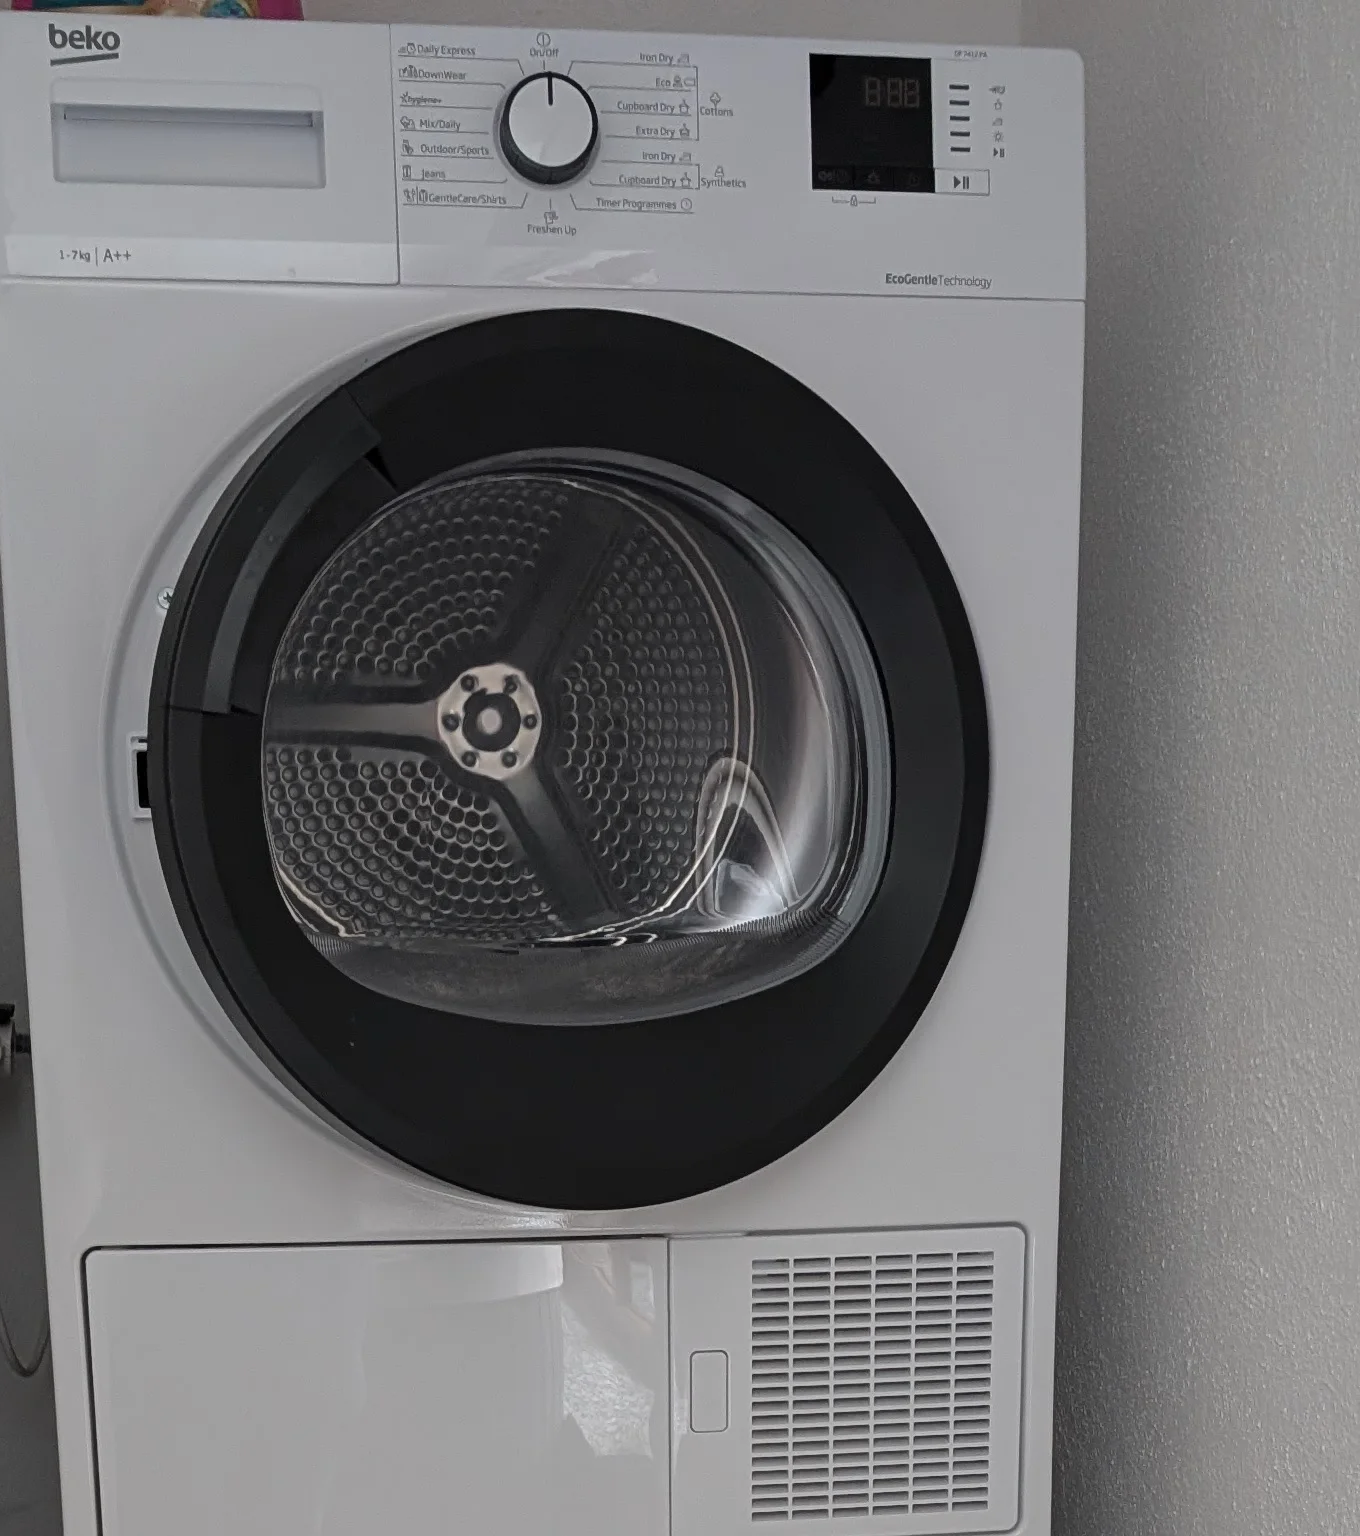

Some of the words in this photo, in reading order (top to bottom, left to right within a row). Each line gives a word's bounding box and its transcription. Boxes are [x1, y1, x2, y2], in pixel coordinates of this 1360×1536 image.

[47, 23, 121, 51] beko
[418, 45, 439, 55] Daily
[441, 46, 476, 56] Express
[529, 48, 559, 58] On/Off
[640, 53, 657, 61] Iron
[659, 54, 674, 63] Dry
[656, 78, 671, 87] Eco
[617, 100, 659, 113] Cupboard
[660, 103, 675, 112] Dry
[700, 106, 733, 117] Cottons
[420, 119, 461, 131] Mix/Daily
[636, 126, 658, 135] Extra
[660, 127, 675, 136] Dry
[420, 144, 489, 156] Outdoor/Sports
[642, 152, 659, 160] Iron
[661, 152, 676, 162] Dry
[619, 175, 659, 186] Cupboard
[662, 176, 676, 187] Dry
[701, 177, 746, 189] Synthetics
[596, 198, 620, 207] Timer
[623, 199, 676, 211] Programmes
[527, 224, 563, 235] Freshen
[565, 225, 577, 236] Up
[103, 248, 132, 262] A++
